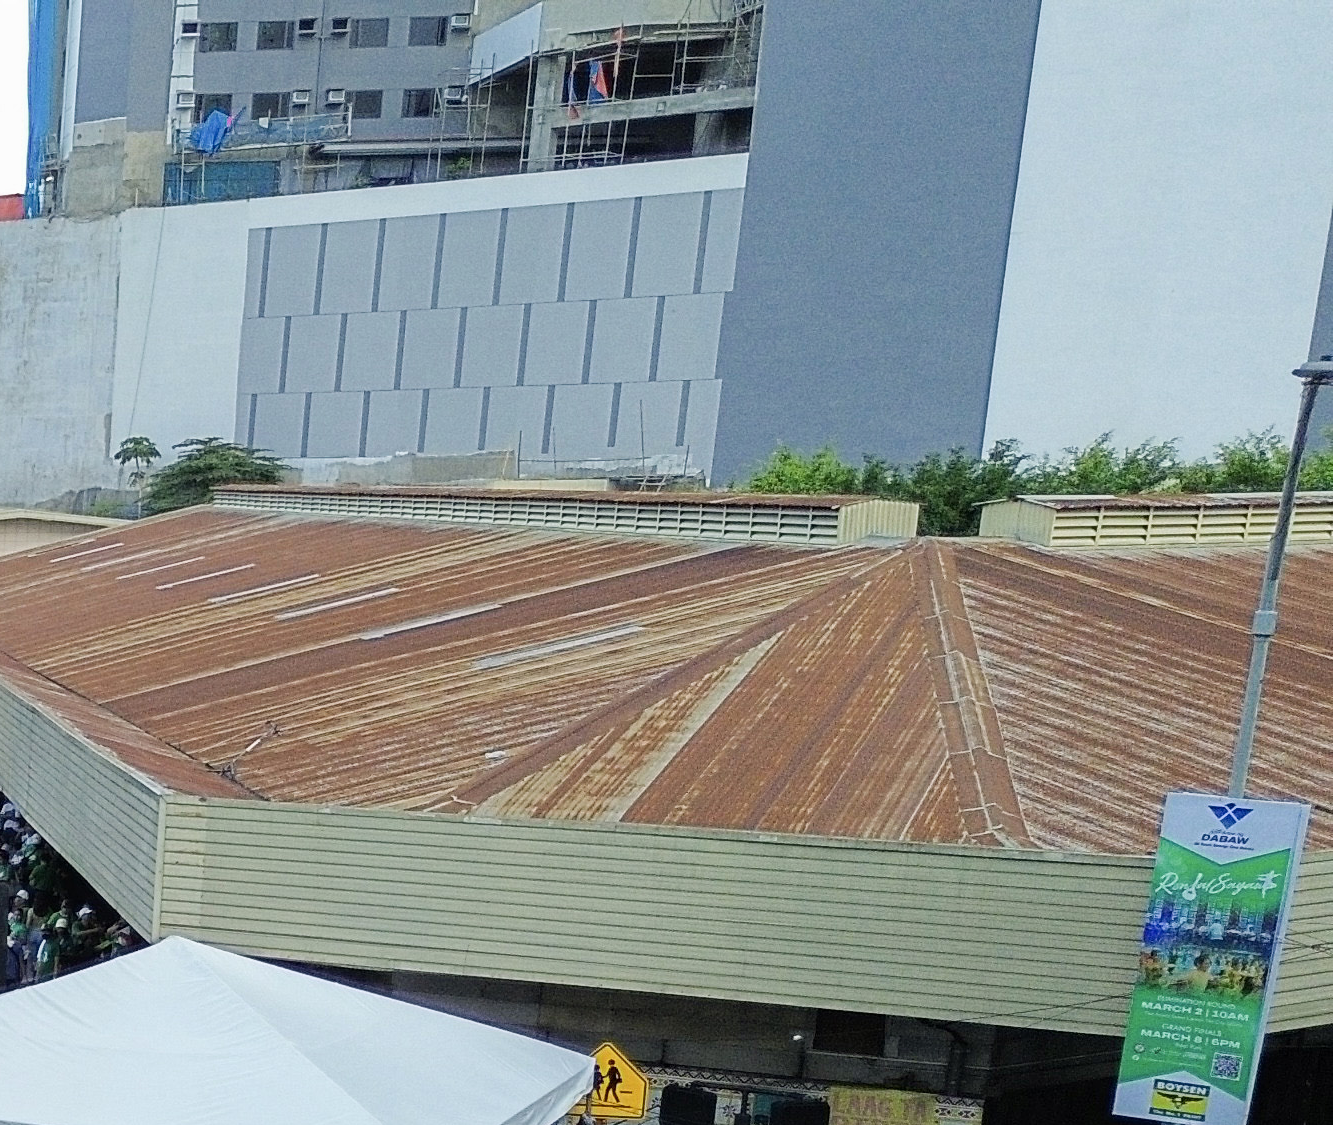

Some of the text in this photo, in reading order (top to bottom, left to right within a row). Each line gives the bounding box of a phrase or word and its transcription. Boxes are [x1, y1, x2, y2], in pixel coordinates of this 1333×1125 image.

[1201, 833, 1250, 845] DABAW
[1141, 1001, 1192, 1014] MARCH
[1194, 1008, 1203, 1016] 2
[1211, 1010, 1250, 1022] 10AM
[1162, 1023, 1192, 1033] GRAND
[1140, 1029, 1191, 1042] MARCH
[1211, 1038, 1241, 1049] 6PM
[1156, 1081, 1207, 1096] BOYSEN
